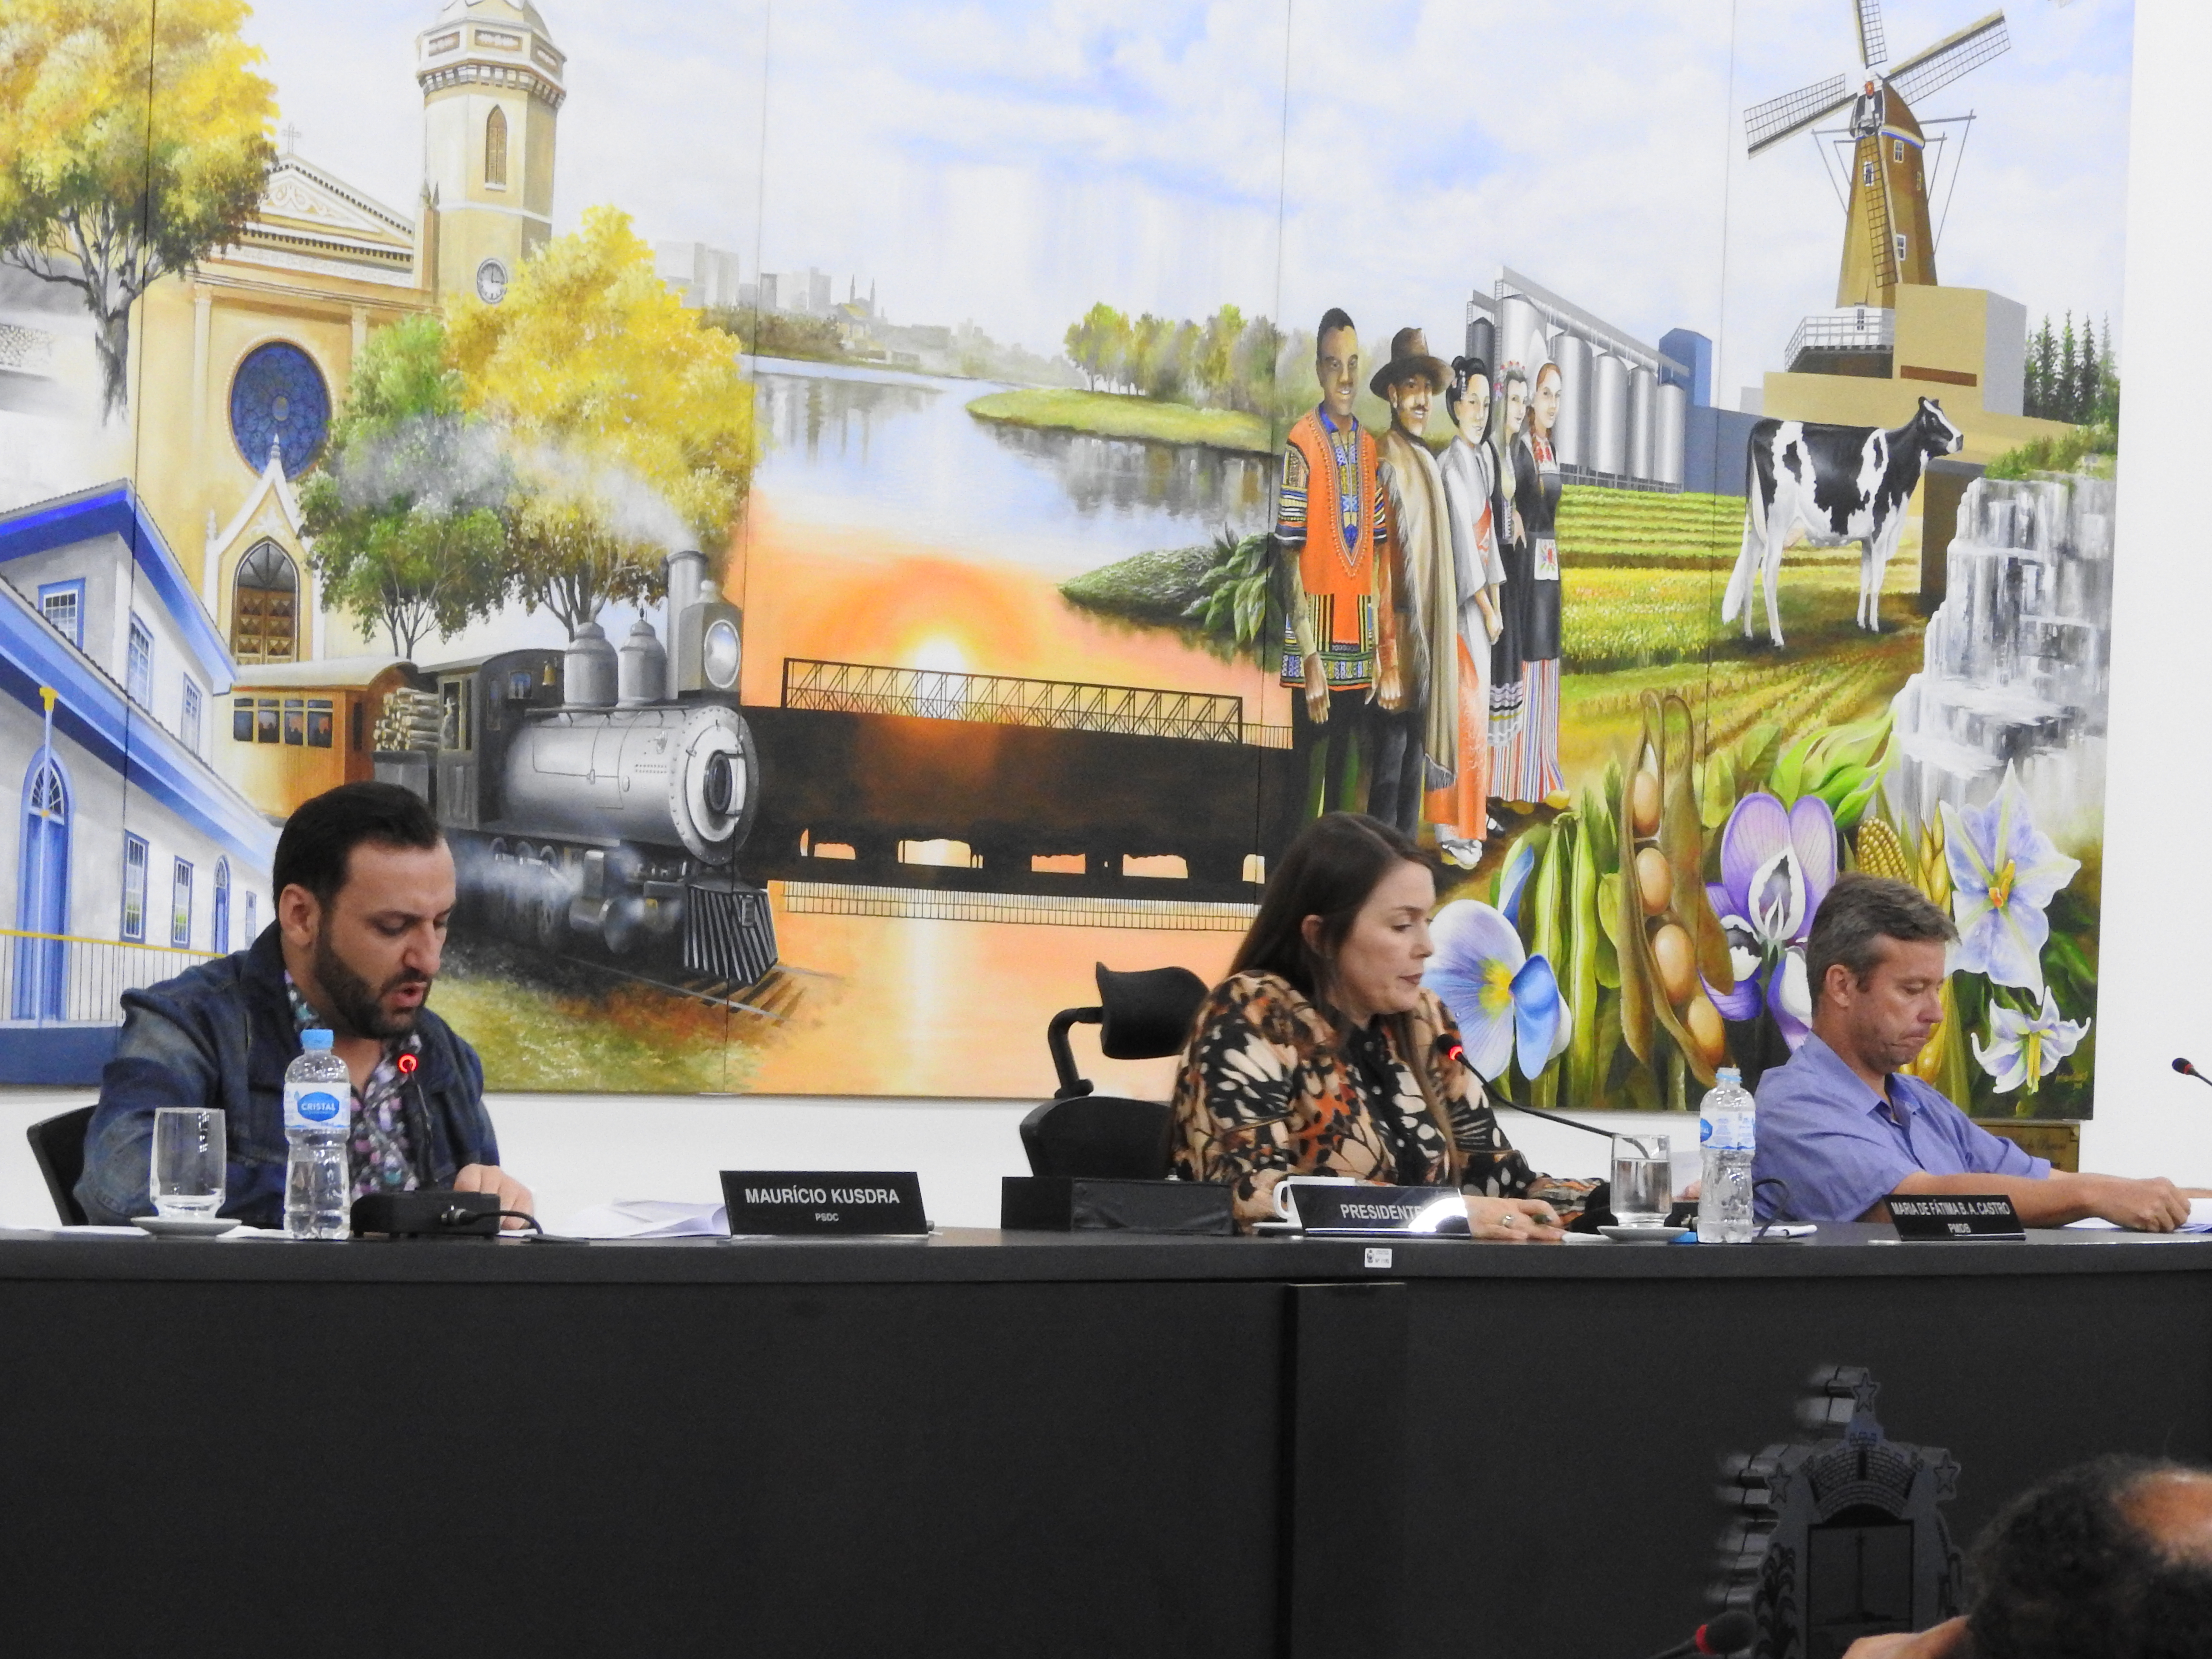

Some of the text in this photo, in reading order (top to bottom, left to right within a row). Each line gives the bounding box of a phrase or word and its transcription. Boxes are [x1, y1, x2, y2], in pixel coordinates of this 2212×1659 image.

[301, 1102, 336, 1111] CRISTAL
[745, 1185, 901, 1203] MAURÍCIO KUSDRA
[1890, 1202, 1919, 1215] MARIA
[1916, 1202, 1931, 1215] DE
[1976, 1202, 2010, 1215] CASTRO
[815, 1213, 839, 1222] PSDC
[1948, 1223, 1972, 1233] PMDB
